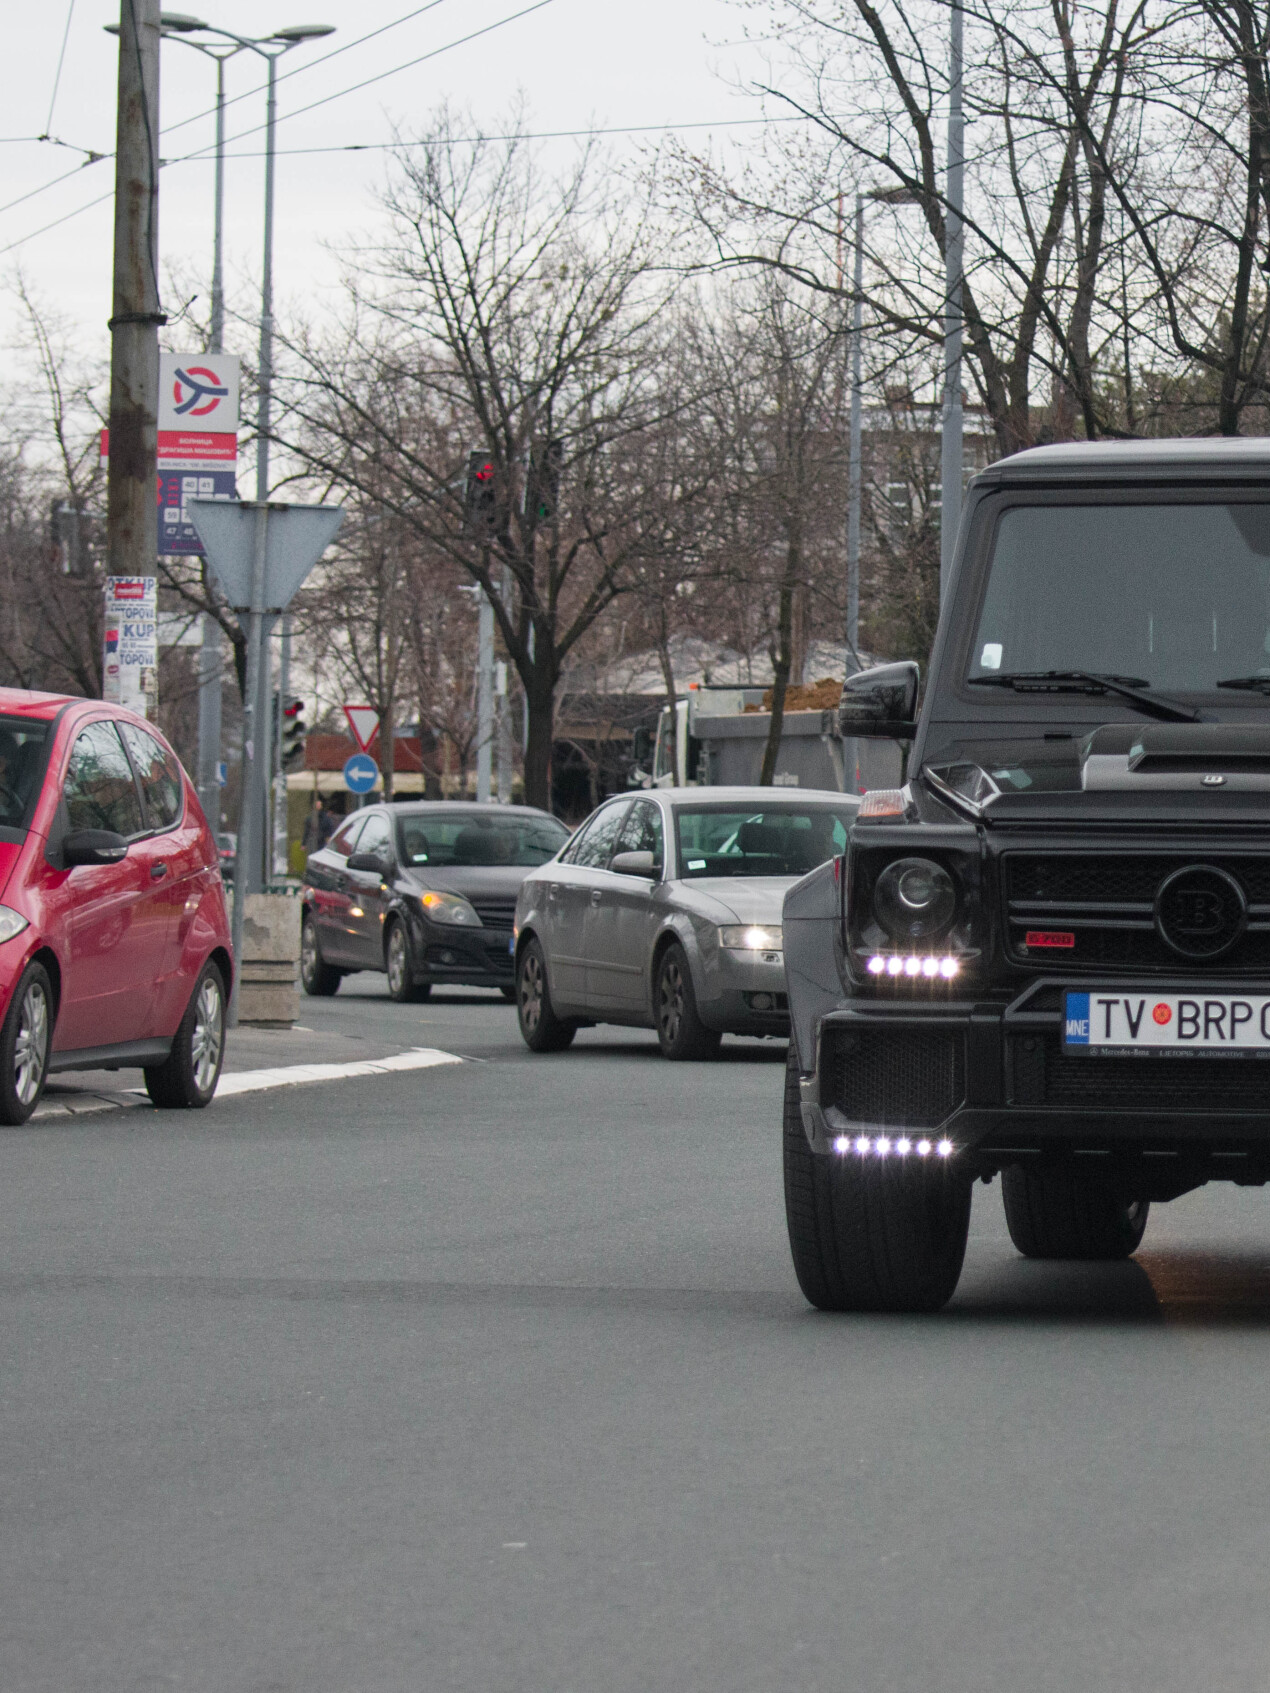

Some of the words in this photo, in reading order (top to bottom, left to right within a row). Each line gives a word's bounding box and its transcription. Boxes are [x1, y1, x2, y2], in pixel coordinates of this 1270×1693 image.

[1098, 999, 1146, 1039] TV
[1066, 1020, 1089, 1036] MNE
[1101, 1047, 1150, 1056] Mercedes-Benz
